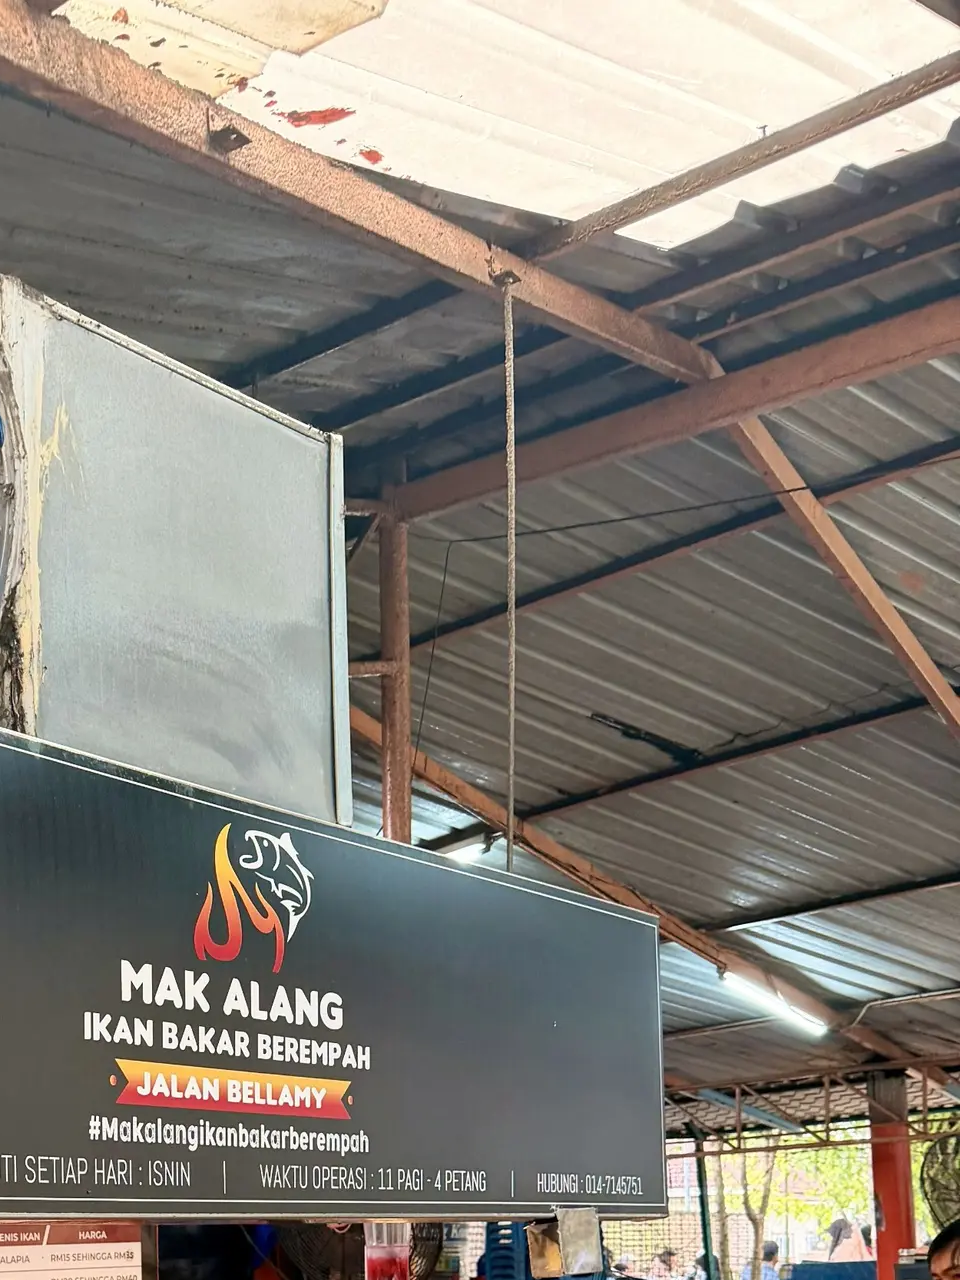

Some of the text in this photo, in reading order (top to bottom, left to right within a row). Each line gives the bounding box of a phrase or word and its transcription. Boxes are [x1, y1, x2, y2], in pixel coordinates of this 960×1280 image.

[120, 959, 343, 1030] MAK ALANG
[83, 1011, 371, 1070] IKAN BAKAR BEREMPAH
[136, 1072, 327, 1109] JALAN BELLAMY
[89, 1115, 369, 1156] #Makalangikanbakarberempah
[24, 1155, 88, 1184] SETIAP
[94, 1158, 132, 1185] HARI
[148, 1160, 190, 1187] ISNIN
[260, 1164, 307, 1189] WAKTU
[313, 1165, 366, 1190] OPERASI
[378, 1168, 394, 1190] 11
[397, 1168, 423, 1191] PAGI
[434, 1170, 441, 1191] 4
[445, 1170, 486, 1192] PETANG
[537, 1173, 579, 1193] HUBUNGI
[585, 1175, 643, 1195] 014-7145751
[20, 1232, 40, 1241] IKAN
[79, 1231, 107, 1240] HARGA
[50, 1253, 70, 1262] RM15
[72, 1252, 112, 1262] SEHINGGA
